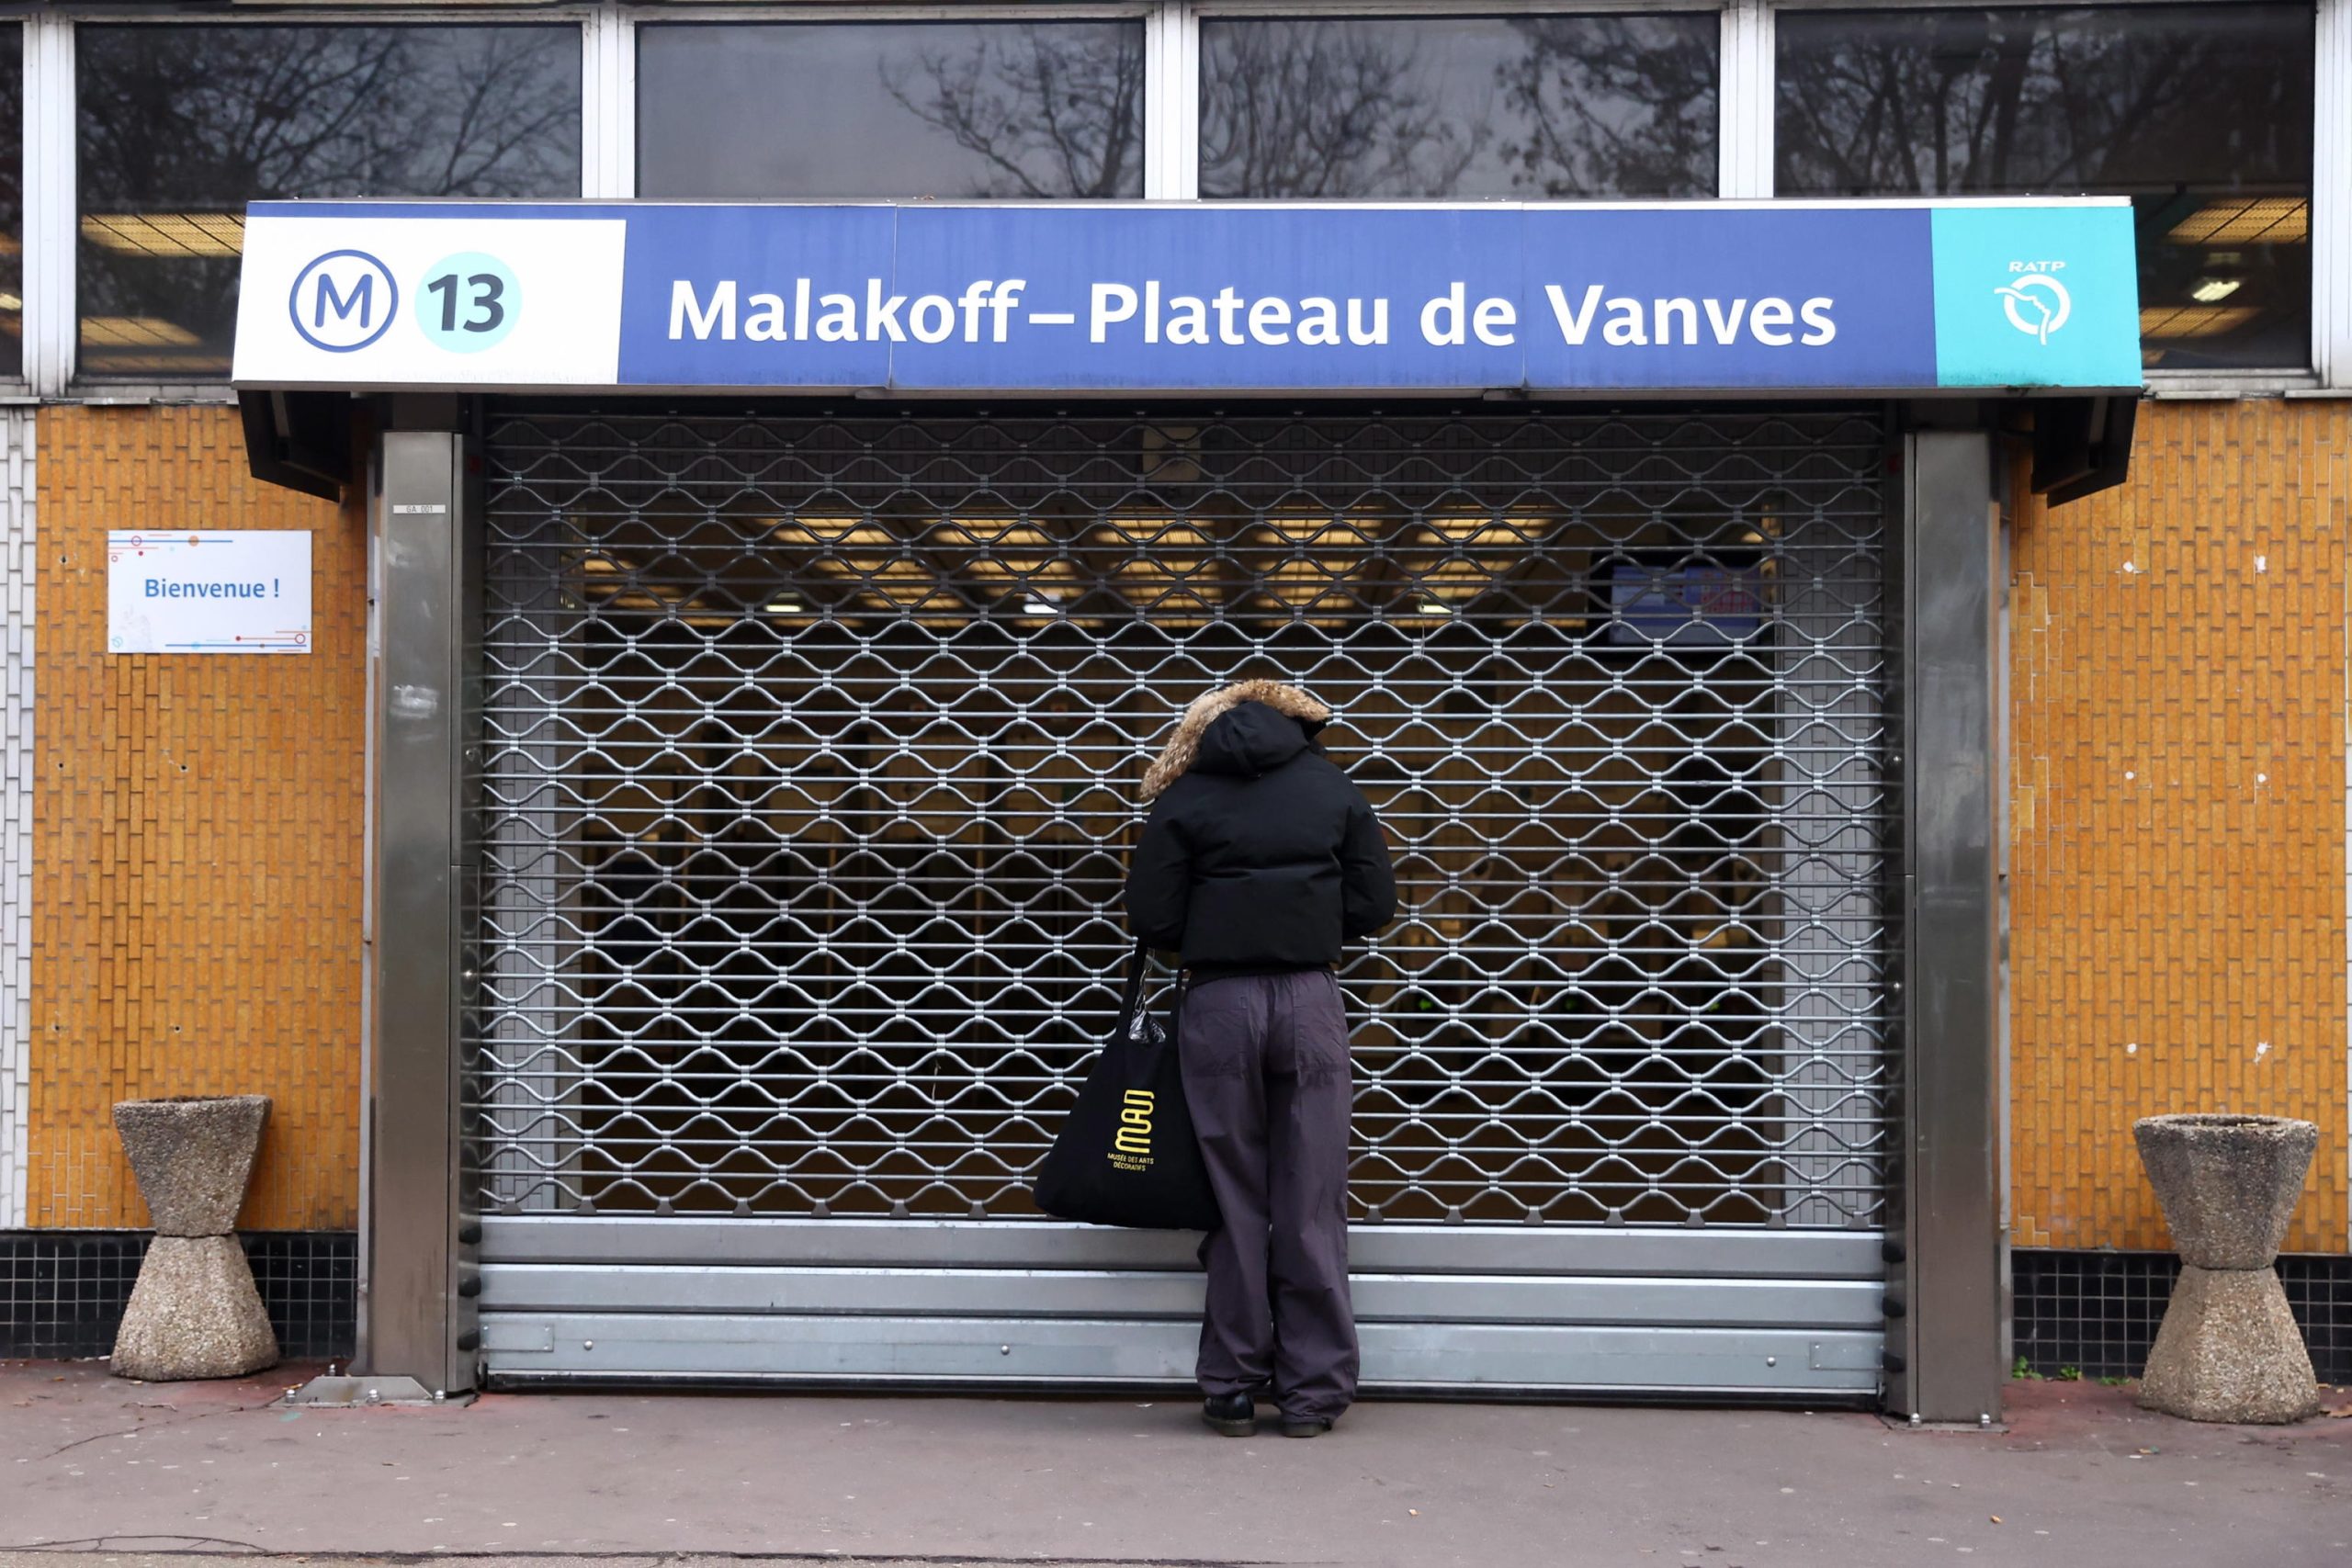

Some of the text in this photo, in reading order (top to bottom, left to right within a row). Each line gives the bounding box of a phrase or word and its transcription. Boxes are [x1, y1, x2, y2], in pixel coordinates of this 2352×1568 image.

[2008, 261, 2065, 272] RATP
[314, 273, 504, 333] M 13
[1419, 281, 1517, 346] de
[1545, 284, 1837, 346] Vanves
[144, 578, 266, 598] Bienvenue
